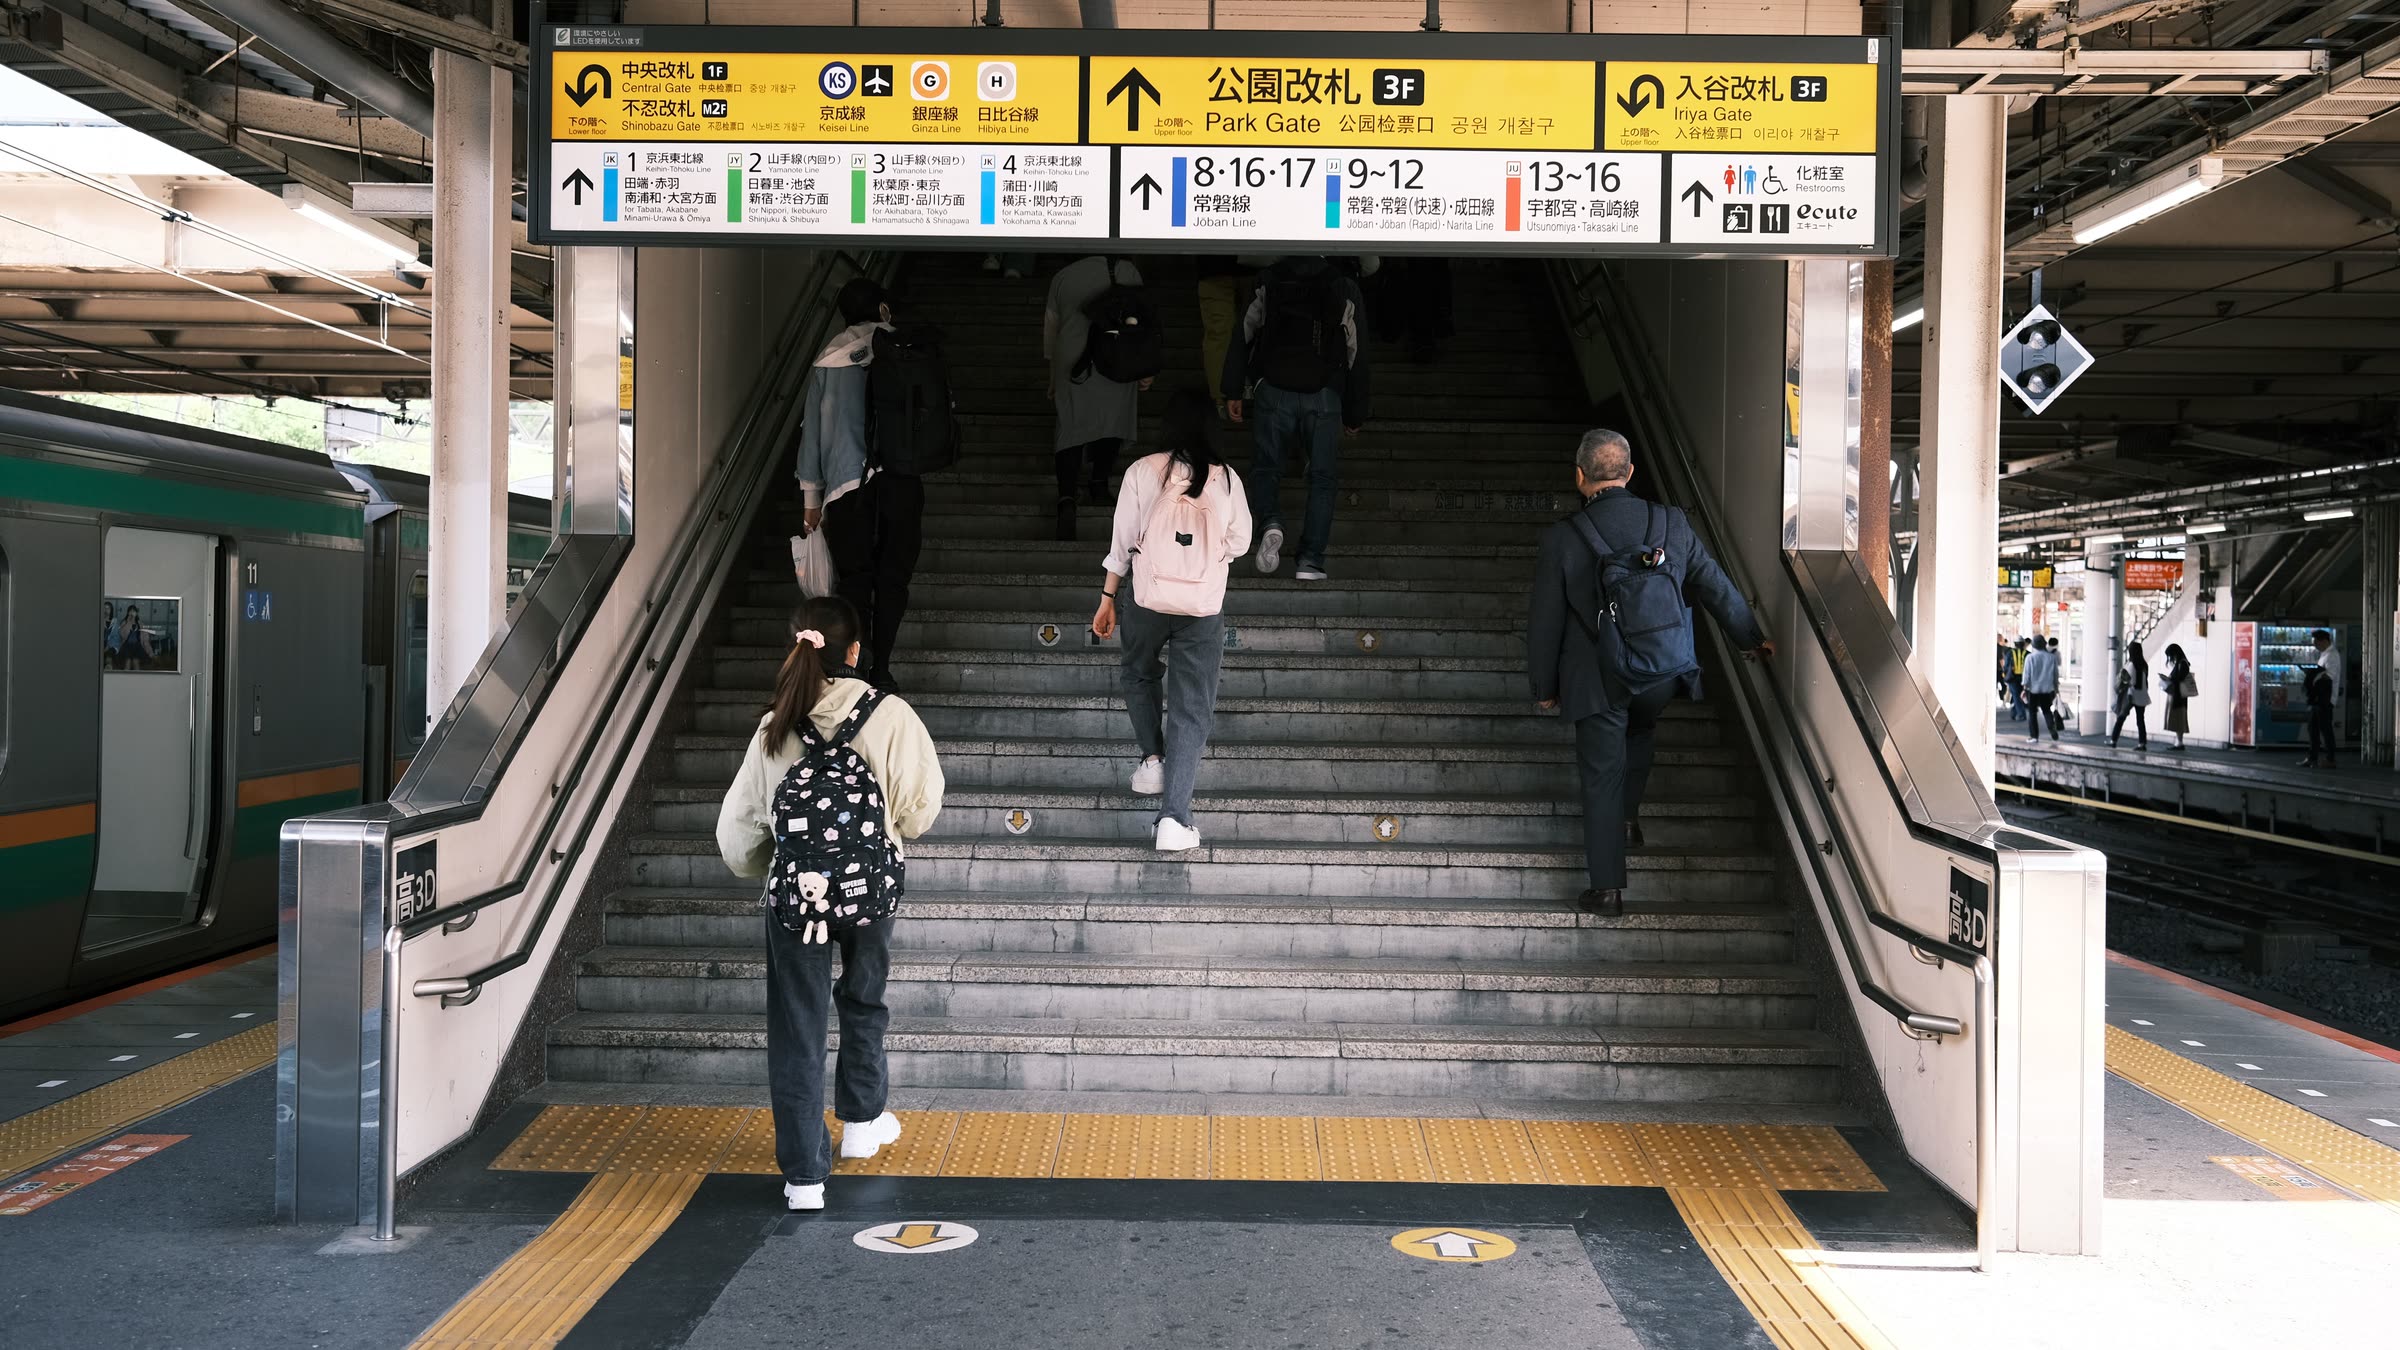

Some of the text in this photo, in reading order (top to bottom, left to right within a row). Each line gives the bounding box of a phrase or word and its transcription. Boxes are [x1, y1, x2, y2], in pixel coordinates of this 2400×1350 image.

[622, 61, 723, 79] 中央改札 1F
[829, 72, 846, 89] KS
[925, 75, 936, 87] G
[992, 76, 1002, 87] H
[1207, 66, 1415, 106] 公園改札 3F
[622, 83, 691, 93] Central Gate
[749, 84, 797, 93] 중앙 개찰구
[1675, 75, 1820, 102] 入谷改札 3F
[622, 99, 726, 117] 不忍改札 M2F
[820, 106, 866, 121] 京成線
[913, 107, 958, 122] 銀座線
[979, 107, 1039, 122] 日比谷線
[1674, 107, 1752, 124] Iriya Gate
[569, 117, 607, 126] 下の階へ
[622, 121, 701, 131] Shinobazu Gate
[752, 123, 805, 131] 시노바즈 개찰구
[1154, 117, 1193, 128] 上の階へ
[1206, 112, 1321, 134] Park Gate
[1338, 114, 1434, 134] 公园检票口
[1451, 116, 1555, 136] 공원 개찰구
[819, 124, 869, 132] Keisei Line
[912, 124, 961, 133] Ginza Line
[978, 125, 1029, 135] Hibiya Line
[1154, 128, 1193, 137] Upper floor
[1620, 128, 1659, 137] 上の階へ
[1675, 127, 1742, 140] 入谷检票口
[1753, 128, 1840, 141] 이리야 개찰구
[1621, 139, 1641, 147] Upper
[628, 152, 703, 171] 1 京浜東北線
[749, 153, 841, 172] 2 山手線(内回り)
[873, 154, 965, 173] 3 山手線(外回り)
[1003, 155, 1082, 174] 4 京浜東北線
[1796, 166, 1844, 181] 化粧室
[625, 177, 679, 189] 田端・赤羽
[749, 178, 815, 190] 日暮里・池袋
[873, 179, 940, 191] 秋葉原・東京
[1003, 180, 1058, 192] 蒲田・川崎
[1796, 183, 1845, 192] Restrooms
[625, 192, 716, 204] 南浦和・大宮方面
[749, 193, 829, 205] 新宿・渋谷方面
[873, 194, 965, 206] 浜松町・品川方面
[1002, 195, 1082, 207] 横浜・関内方面
[1194, 194, 1251, 213] 常磐線
[761, 207, 788, 215] Nippori,
[1527, 199, 1639, 219] 宇都宮・高崎線
[1797, 204, 1857, 220] ecute
[749, 216, 780, 224] Shinjuku
[790, 216, 819, 224] Shibuya
[933, 217, 969, 225] Shinagawa
[1193, 217, 1256, 228] Jōban Line
[1476, 221, 1493, 230] Line
[1621, 223, 1639, 233] Line
[248, 563, 257, 583] 11
[840, 878, 866, 889] SUPERIOR
[396, 869, 436, 925] 高3D
[845, 886, 868, 898] CLOUD
[1950, 890, 1987, 949] 高3D
